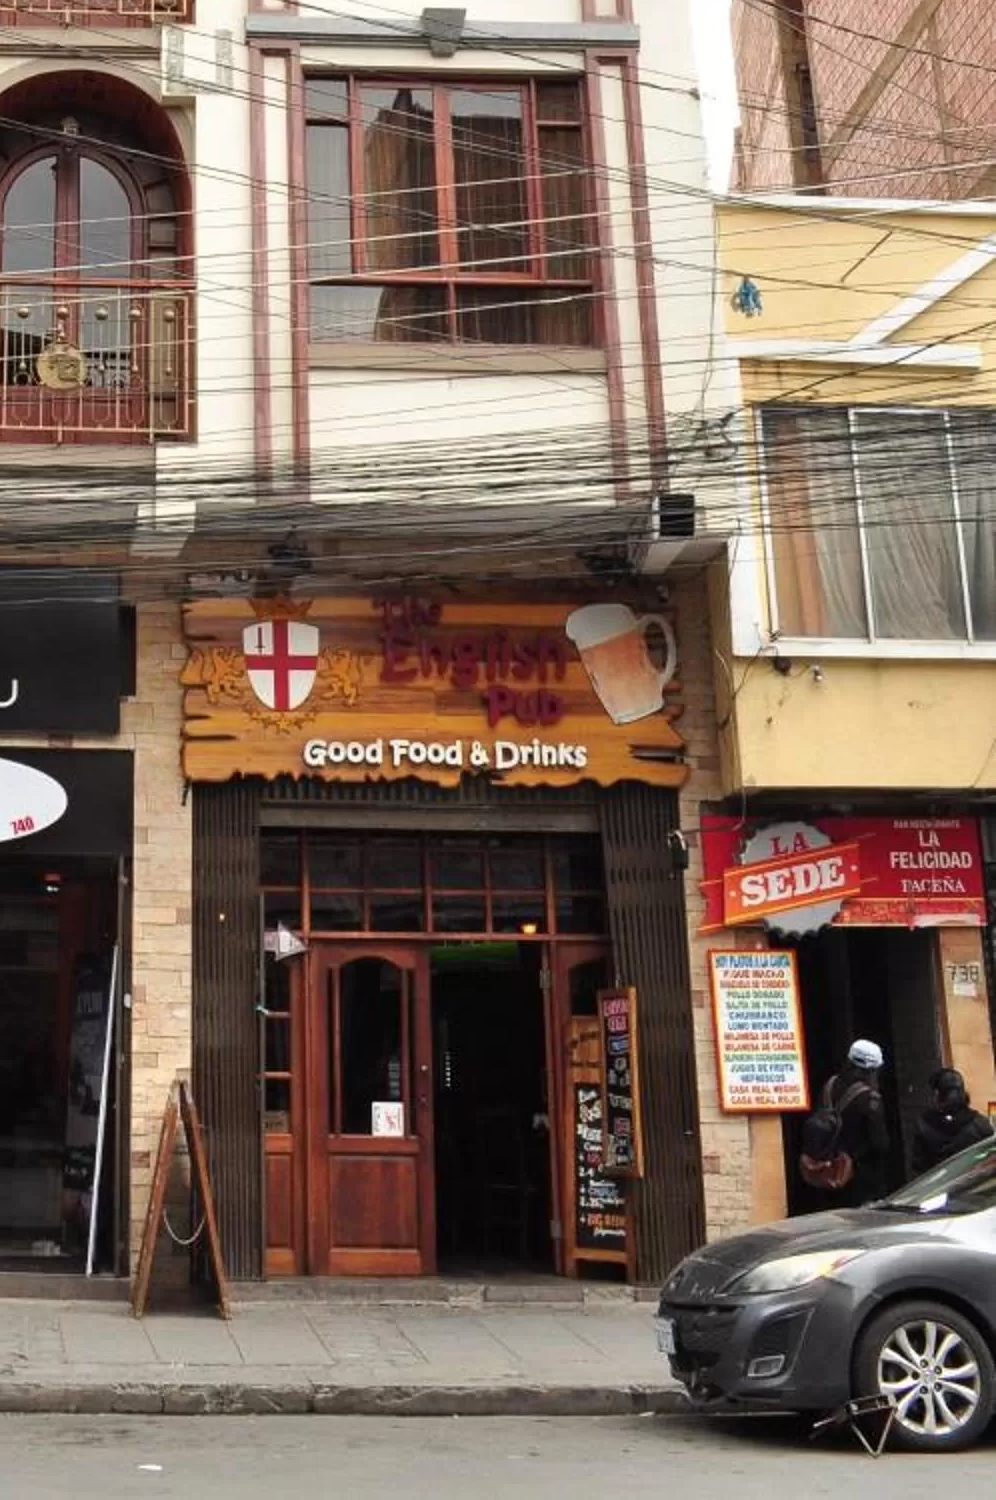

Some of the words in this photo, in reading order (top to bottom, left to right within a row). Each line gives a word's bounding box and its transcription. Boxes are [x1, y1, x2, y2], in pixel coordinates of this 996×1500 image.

[380, 629, 568, 688] English
[484, 685, 565, 729] Pub
[304, 739, 383, 767] Good
[389, 739, 463, 767] Food
[470, 740, 490, 766] &
[495, 738, 588, 769] Drinks
[770, 832, 811, 856] LA
[919, 830, 940, 847] LA
[889, 851, 973, 869] FELICIDAD
[740, 856, 846, 907] SEDE
[900, 875, 966, 893] PACEÑA
